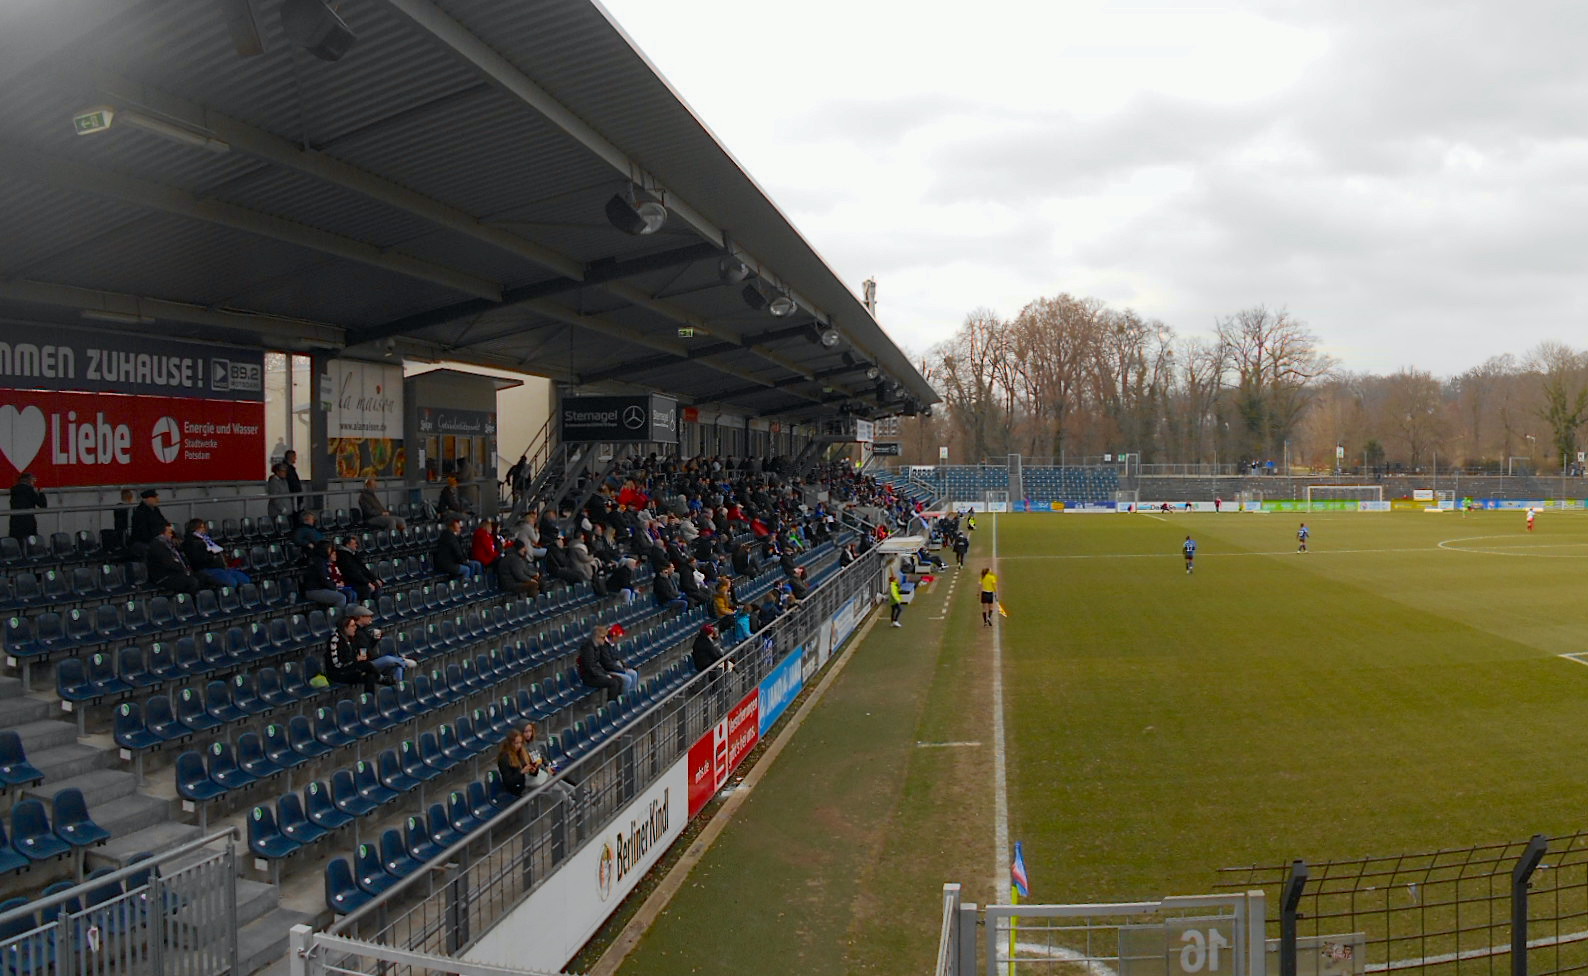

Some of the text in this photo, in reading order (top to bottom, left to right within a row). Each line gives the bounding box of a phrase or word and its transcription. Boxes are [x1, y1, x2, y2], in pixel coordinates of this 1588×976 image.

[86, 348, 204, 388] ZUHAUSE!
[231, 365, 259, 381] 89.2
[356, 396, 395, 413] maison
[184, 421, 259, 436] Energie und Wasser
[51, 410, 133, 466] Liebe
[184, 438, 218, 449] Stadtwerke
[184, 450, 211, 460] Potsdam
[728, 697, 758, 735] Versicherungen
[616, 787, 669, 882] Berliner Kindl
